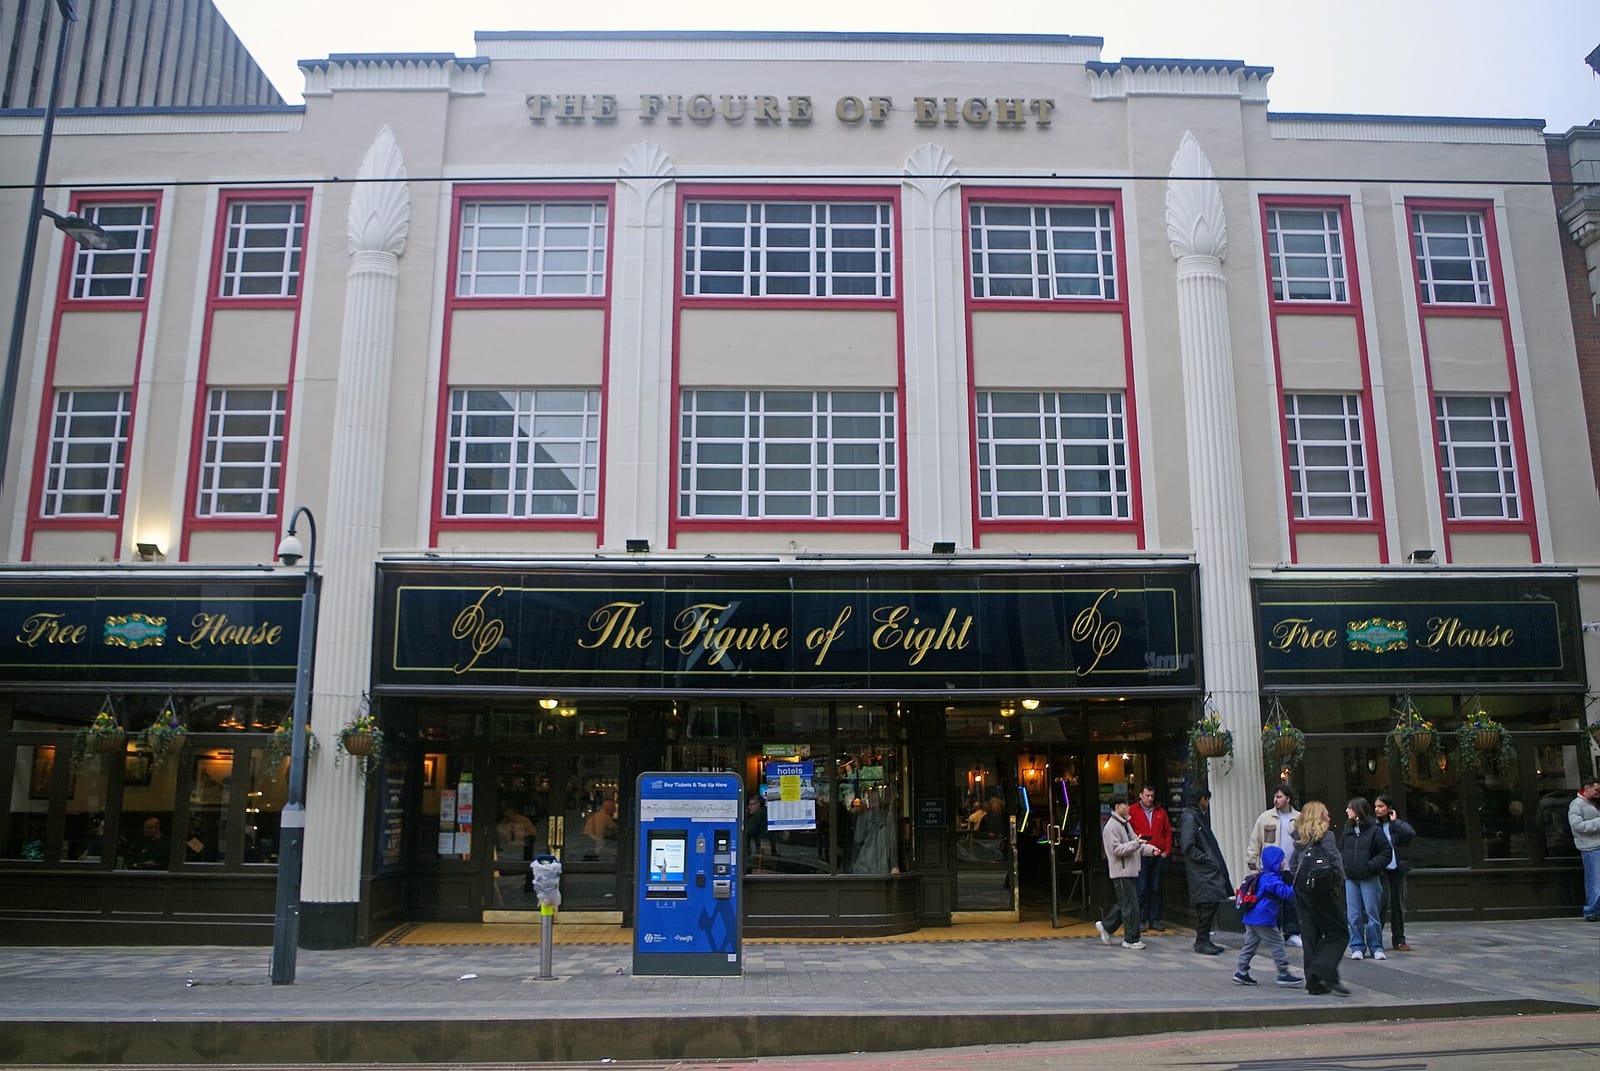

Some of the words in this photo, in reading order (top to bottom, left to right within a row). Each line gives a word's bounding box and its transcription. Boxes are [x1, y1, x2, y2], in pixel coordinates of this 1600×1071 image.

[526, 94, 617, 121] THE
[639, 94, 813, 123] FIGURE
[836, 96, 893, 124] OF
[913, 97, 1056, 125] EIGHT
[15, 612, 88, 648] Free
[176, 612, 283, 650] House
[577, 600, 653, 649] The
[664, 602, 790, 666] Figure
[805, 605, 852, 666] of
[872, 605, 974, 666] Eight
[1268, 617, 1338, 653] Free
[1415, 616, 1514, 652] House
[777, 767, 804, 775] hotels
